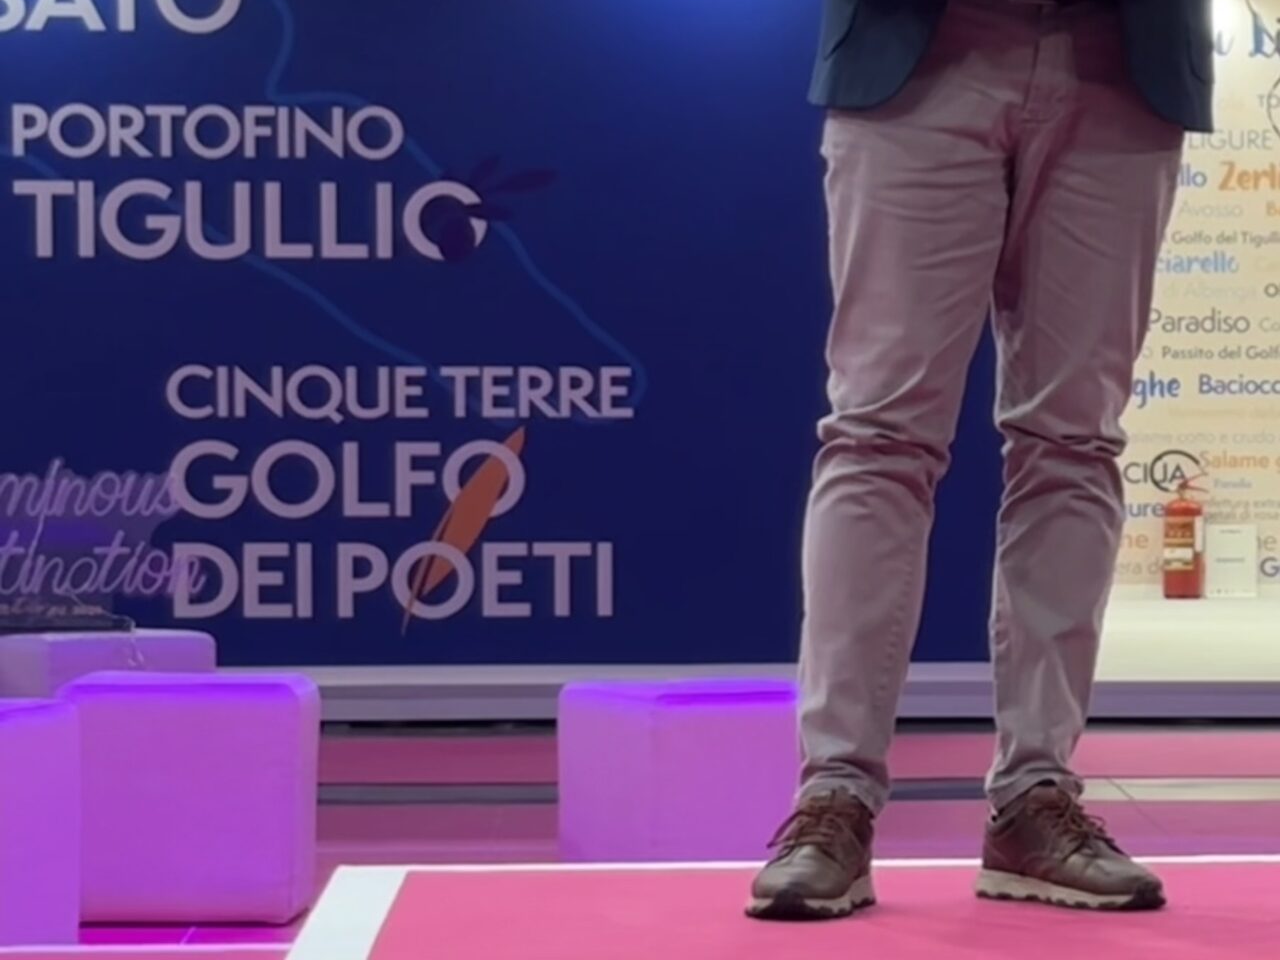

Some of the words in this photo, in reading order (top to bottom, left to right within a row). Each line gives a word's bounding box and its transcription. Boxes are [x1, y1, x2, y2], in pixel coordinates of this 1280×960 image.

[11, 103, 404, 160] PORTOFINO
[1187, 129, 1273, 151] LIGURE
[1171, 230, 1212, 245] Golfo
[1216, 230, 1238, 245] del
[1147, 307, 1251, 333] Paradiso
[1162, 345, 1214, 360] Passito
[1218, 345, 1242, 360] del
[166, 365, 429, 423] CINQUE
[440, 366, 634, 418] TERRE
[1200, 451, 1269, 469] Salame
[172, 440, 526, 519] GOLFO
[173, 542, 313, 619] DEI
[338, 541, 614, 620] POETI
